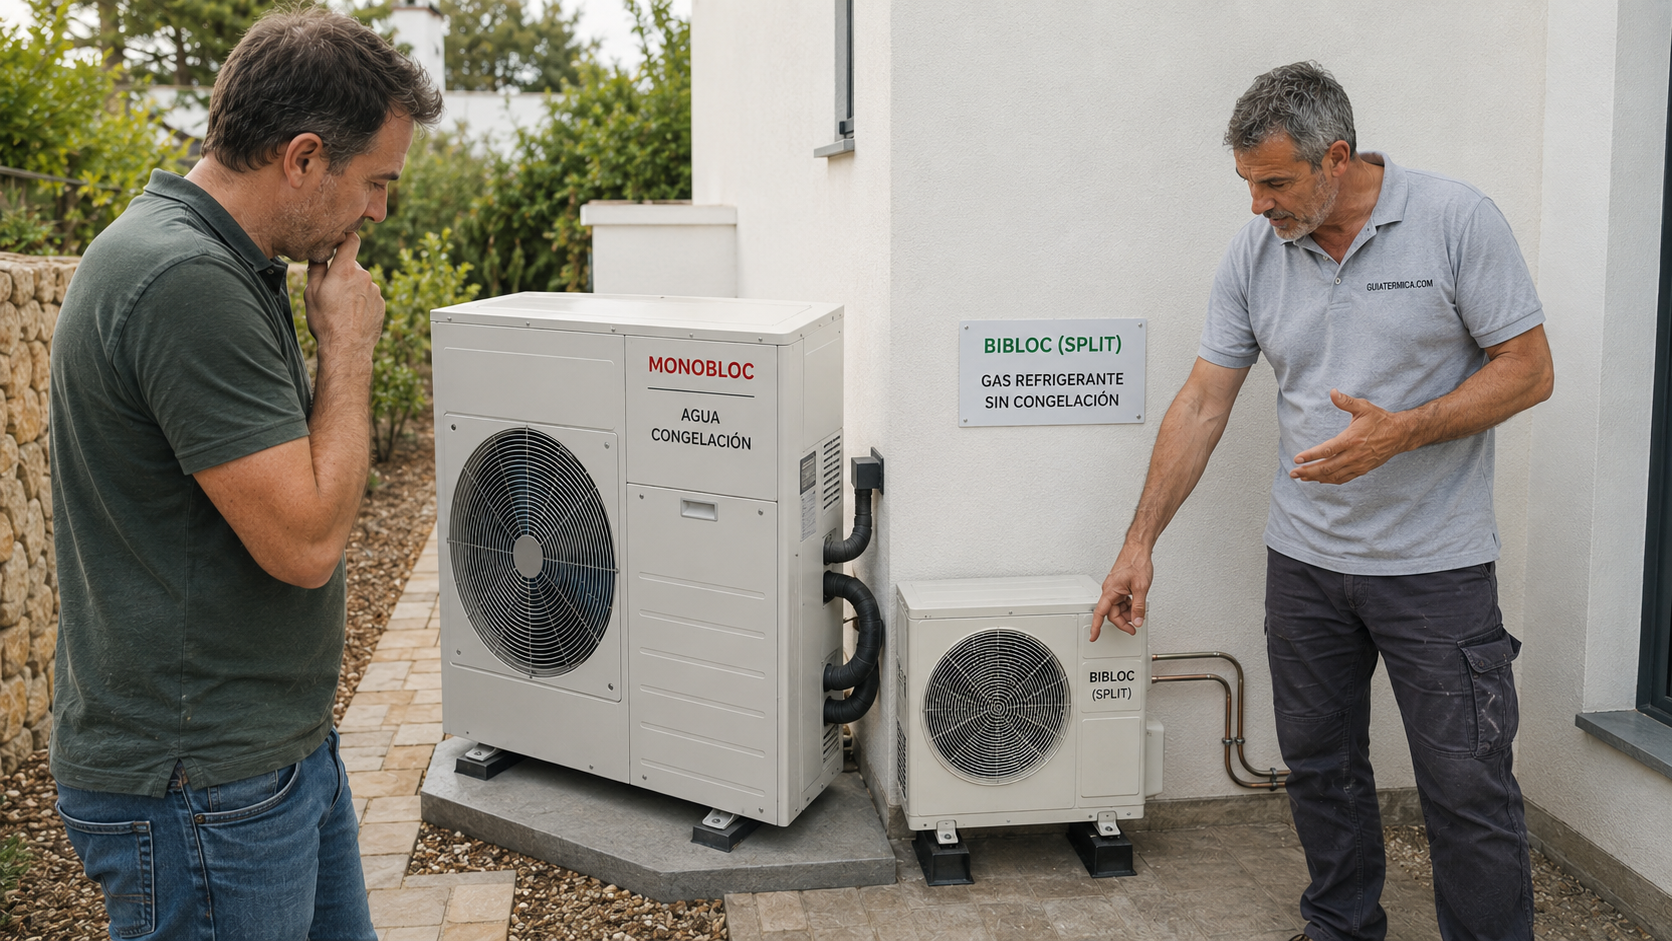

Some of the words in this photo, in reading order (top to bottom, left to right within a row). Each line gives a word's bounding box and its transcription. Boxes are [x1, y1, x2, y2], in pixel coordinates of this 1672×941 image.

[1366, 279, 1434, 291] GUIATERMICA.COM
[984, 337, 1052, 354] BIBLOC
[1058, 335, 1122, 355] (SPLIT)
[648, 355, 755, 380] MONOBLOC
[981, 374, 1011, 387] GAS
[1015, 372, 1124, 387] REFRIGERANTE
[985, 395, 1009, 409] SIN
[1013, 390, 1119, 408] CONGELACIÓN
[681, 407, 720, 424] AGUA
[651, 427, 752, 450] CONGELACIÓN
[1089, 670, 1135, 683] BIBLOC
[1092, 687, 1132, 701] (SPLIT)
